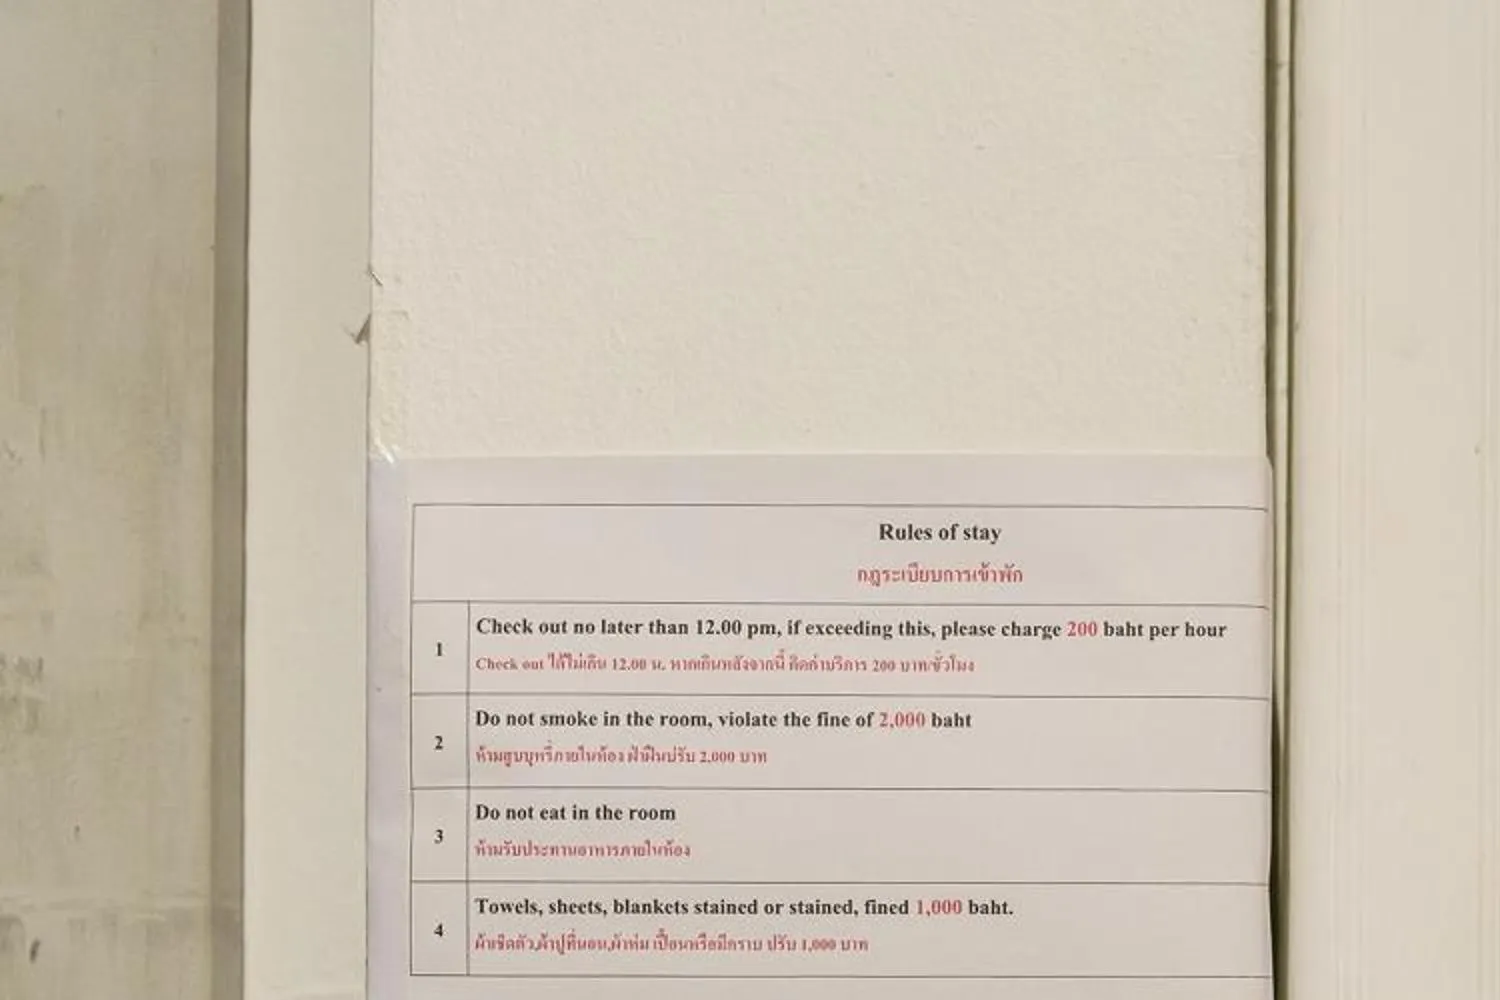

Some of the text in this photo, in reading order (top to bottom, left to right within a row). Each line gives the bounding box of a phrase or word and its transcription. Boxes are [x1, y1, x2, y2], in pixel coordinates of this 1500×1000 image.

[879, 522, 1003, 546] Rules of stay
[475, 617, 1228, 642] Check out no later than 12.00 pm, if exceeding this, please charge 200 baht per hour
[436, 641, 444, 657] 1
[475, 657, 519, 671] Check
[521, 658, 545, 671] out
[612, 657, 647, 671] 12.00
[871, 658, 897, 673] 200
[474, 709, 972, 731] Do not smoke in the room, violate the fine of 2,000 baht
[433, 734, 445, 751] 2
[698, 750, 736, 765] 2,000
[739, 751, 768, 764] บาท
[475, 803, 677, 822] Do not eat in the room
[433, 828, 445, 845] 3
[473, 896, 1015, 919] Towels, sheets, blankets stained or stained, fined 1,000 baht.
[433, 922, 445, 939] 4
[801, 938, 837, 953] 1,000
[840, 938, 869, 952] บาท
